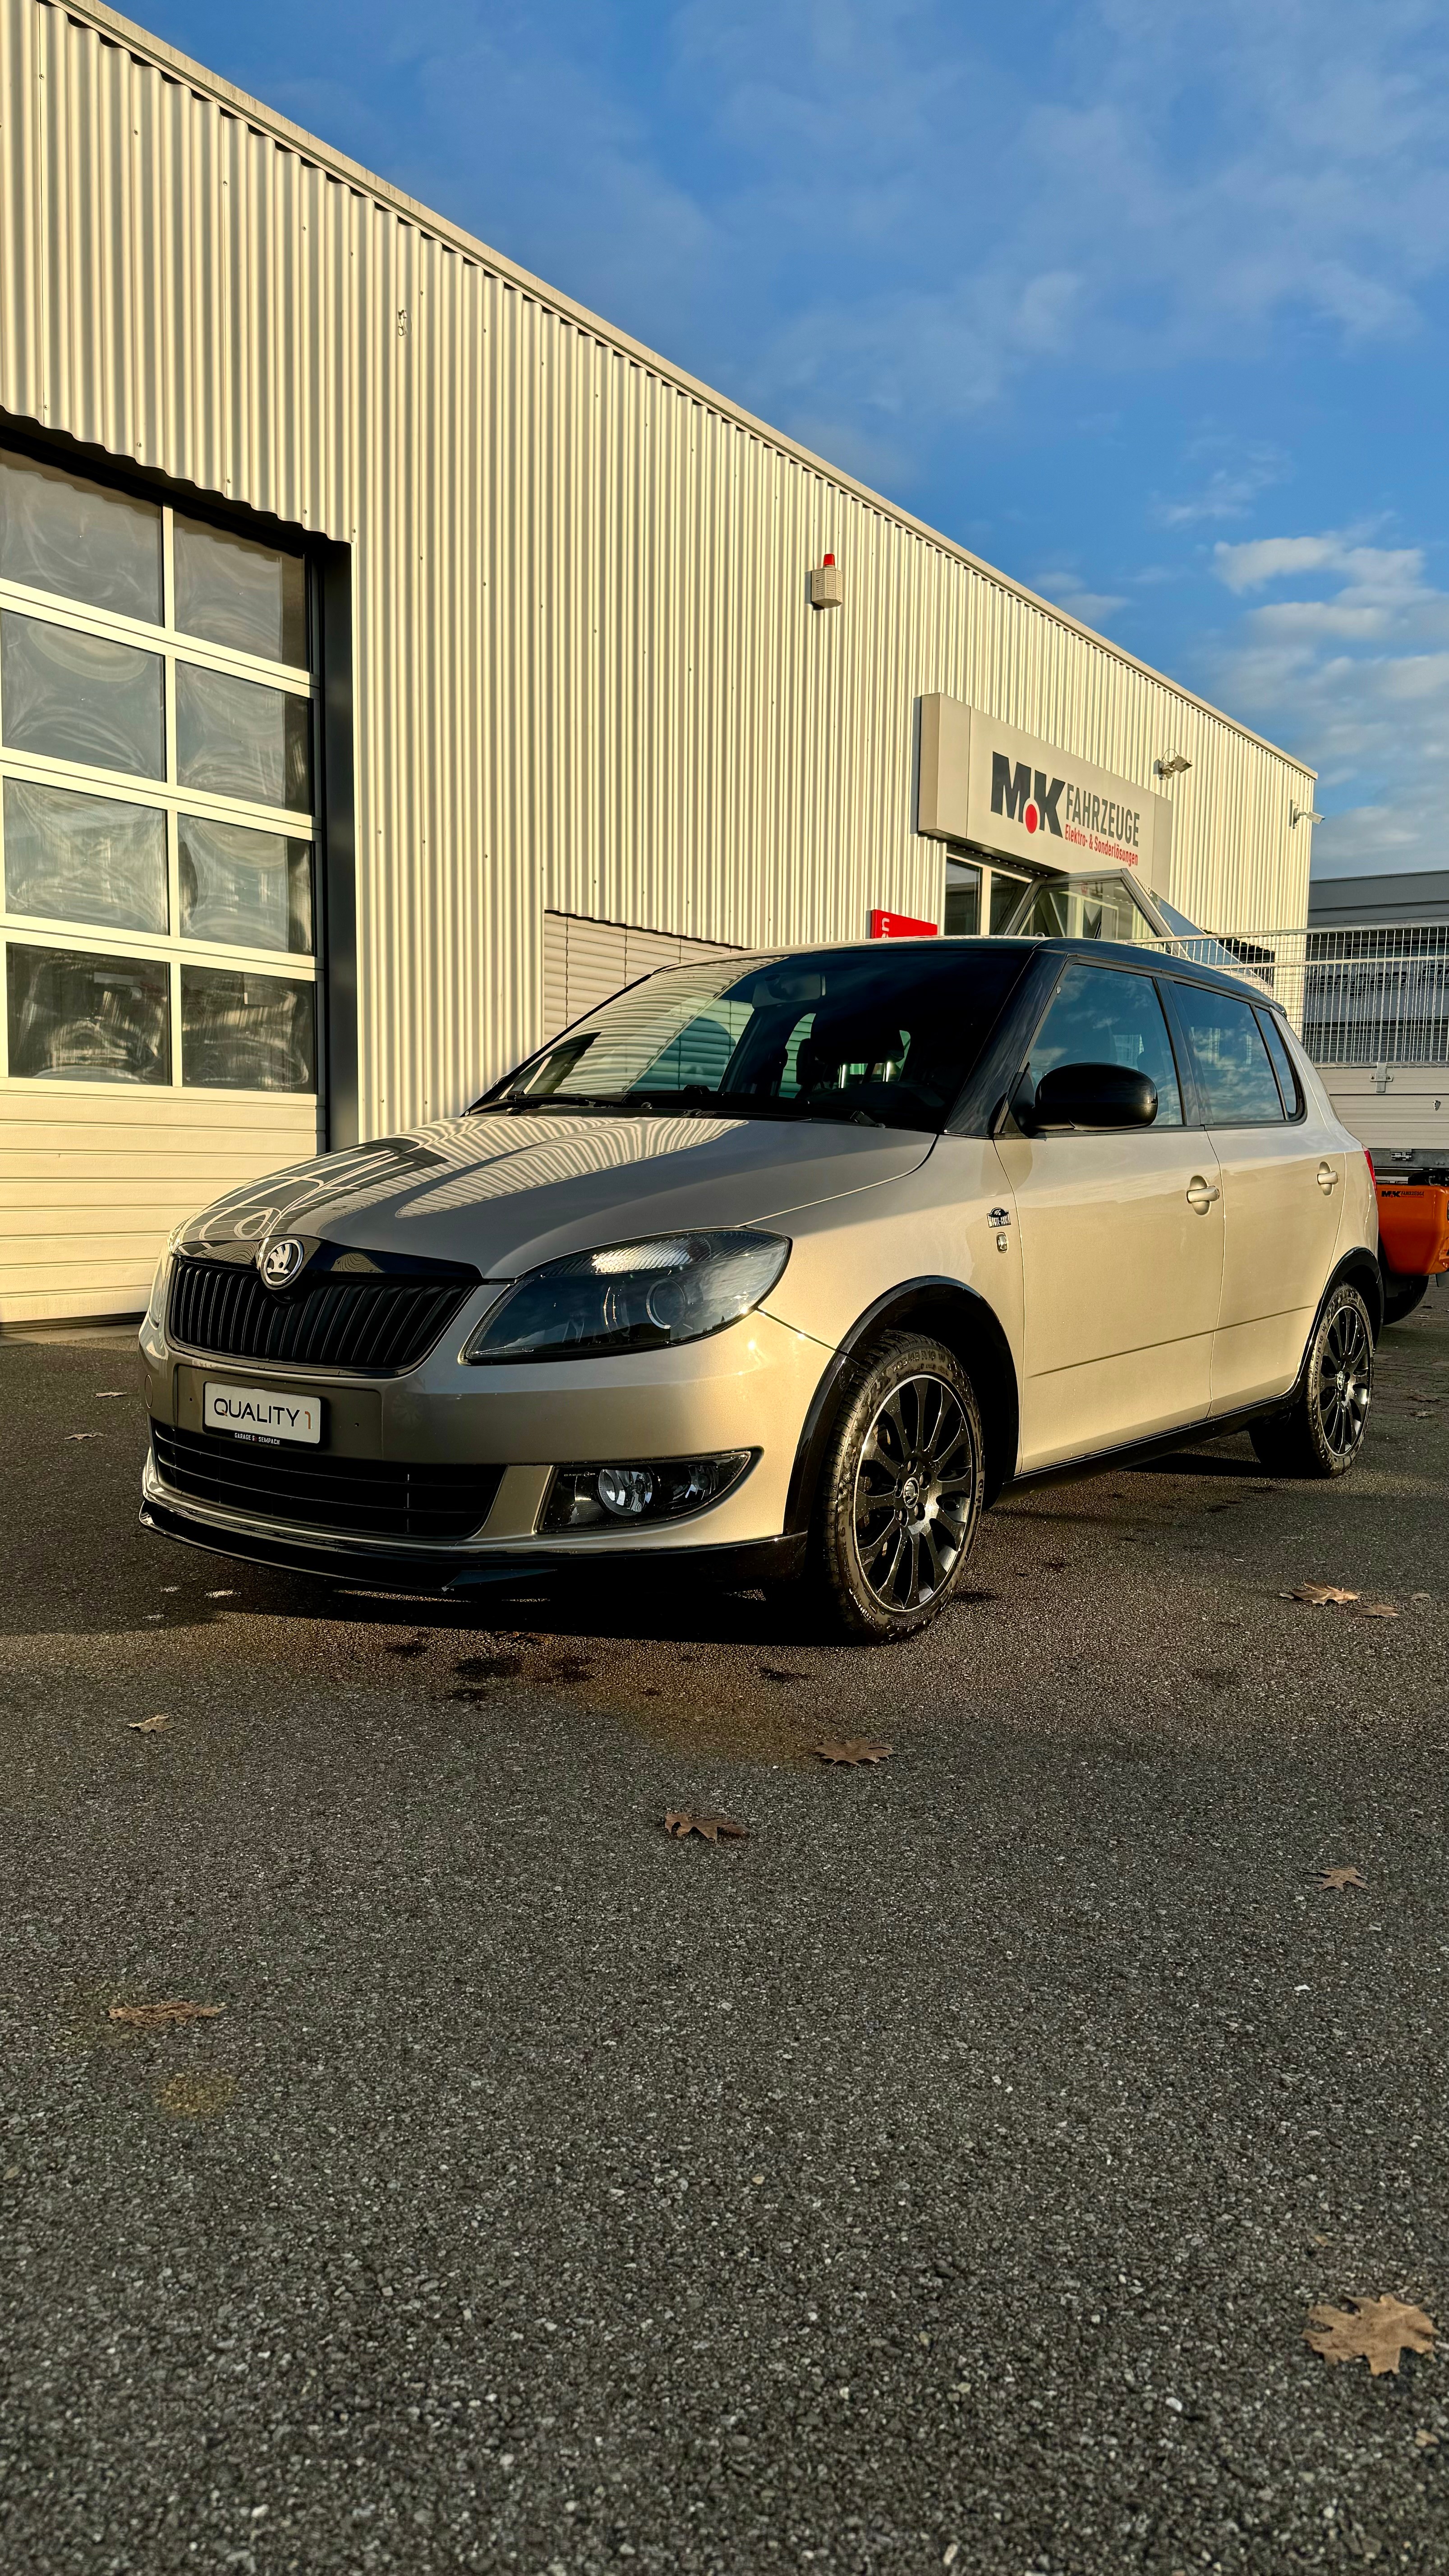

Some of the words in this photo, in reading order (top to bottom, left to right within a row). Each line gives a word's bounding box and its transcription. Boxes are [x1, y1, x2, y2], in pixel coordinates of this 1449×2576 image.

[1066, 783, 1140, 847] FAHRZEUGE
[1065, 824, 1088, 847] Elektro-
[1089, 834, 1093, 850] &
[1094, 836, 1138, 867] Sonderlösungen
[214, 1398, 300, 1427] QUALITY
[304, 1411, 311, 1430] 1
[235, 1432, 251, 1440] GARAGE
[258, 1437, 280, 1445] SEMPACH
